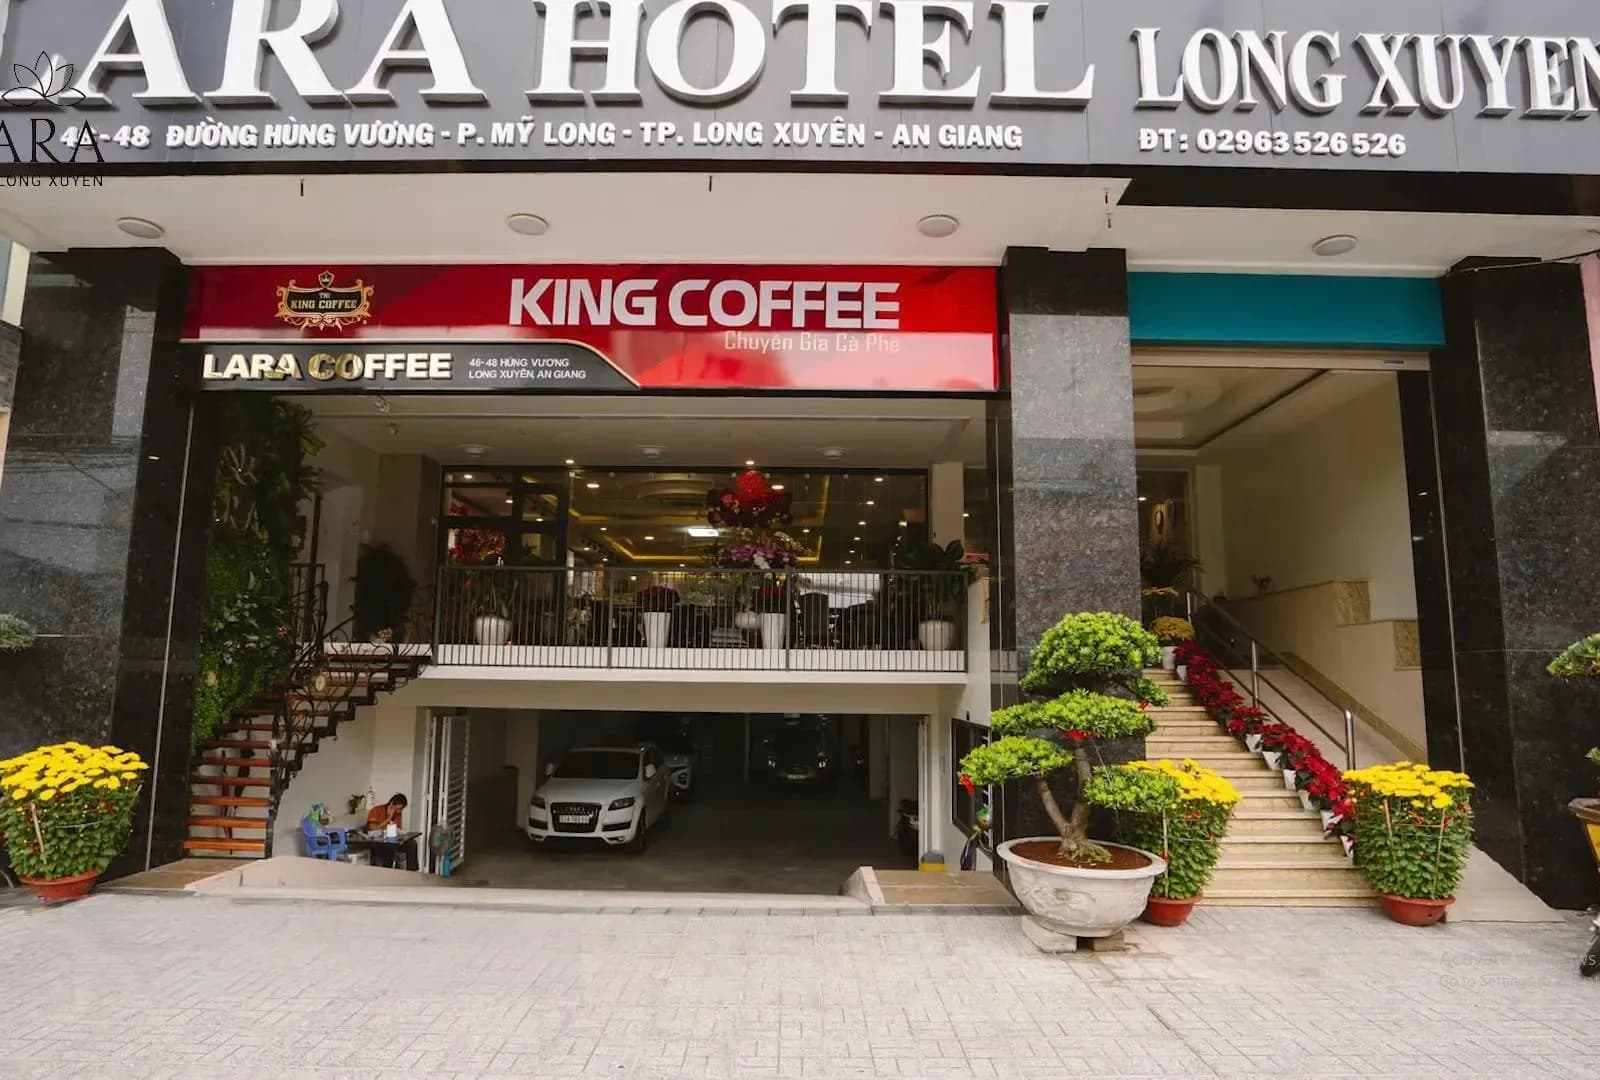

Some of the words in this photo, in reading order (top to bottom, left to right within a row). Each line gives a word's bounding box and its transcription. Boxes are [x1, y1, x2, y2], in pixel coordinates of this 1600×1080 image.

[524, 0, 1095, 104] HOTEL
[1131, 27, 1347, 112] LONG
[1355, 33, 1600, 116] XUYEN
[166, 116, 259, 149] ĐƯỜNG
[263, 116, 337, 148] HÙNG
[343, 119, 435, 148] VƯƠNG
[457, 122, 485, 146] P.
[490, 115, 535, 147] MỸ
[543, 121, 616, 146] LONG
[640, 121, 684, 145] TP.
[692, 121, 764, 146] LONG
[772, 116, 866, 147] XUYÊN
[892, 124, 931, 148] AN
[938, 124, 1024, 149] GIANG
[1139, 127, 1189, 152] ĐT:
[1196, 128, 1290, 154] 02963
[1293, 131, 1349, 155] 526
[1351, 132, 1407, 157] 526
[290, 300, 316, 309] KING
[318, 300, 358, 309] COFFEE
[508, 278, 658, 327] KING
[668, 280, 901, 330] COFFEE
[799, 332, 829, 351] Gia
[202, 353, 302, 380] LARA
[308, 353, 452, 380] COFFEE
[468, 370, 497, 379] LONG
[500, 367, 536, 379] XUYÊN,
[536, 370, 552, 379] AN
[553, 370, 587, 379] GIANG
[469, 358, 498, 367] 46-48
[500, 356, 528, 367] HÙNG
[531, 357, 570, 367] VƯƠNG
